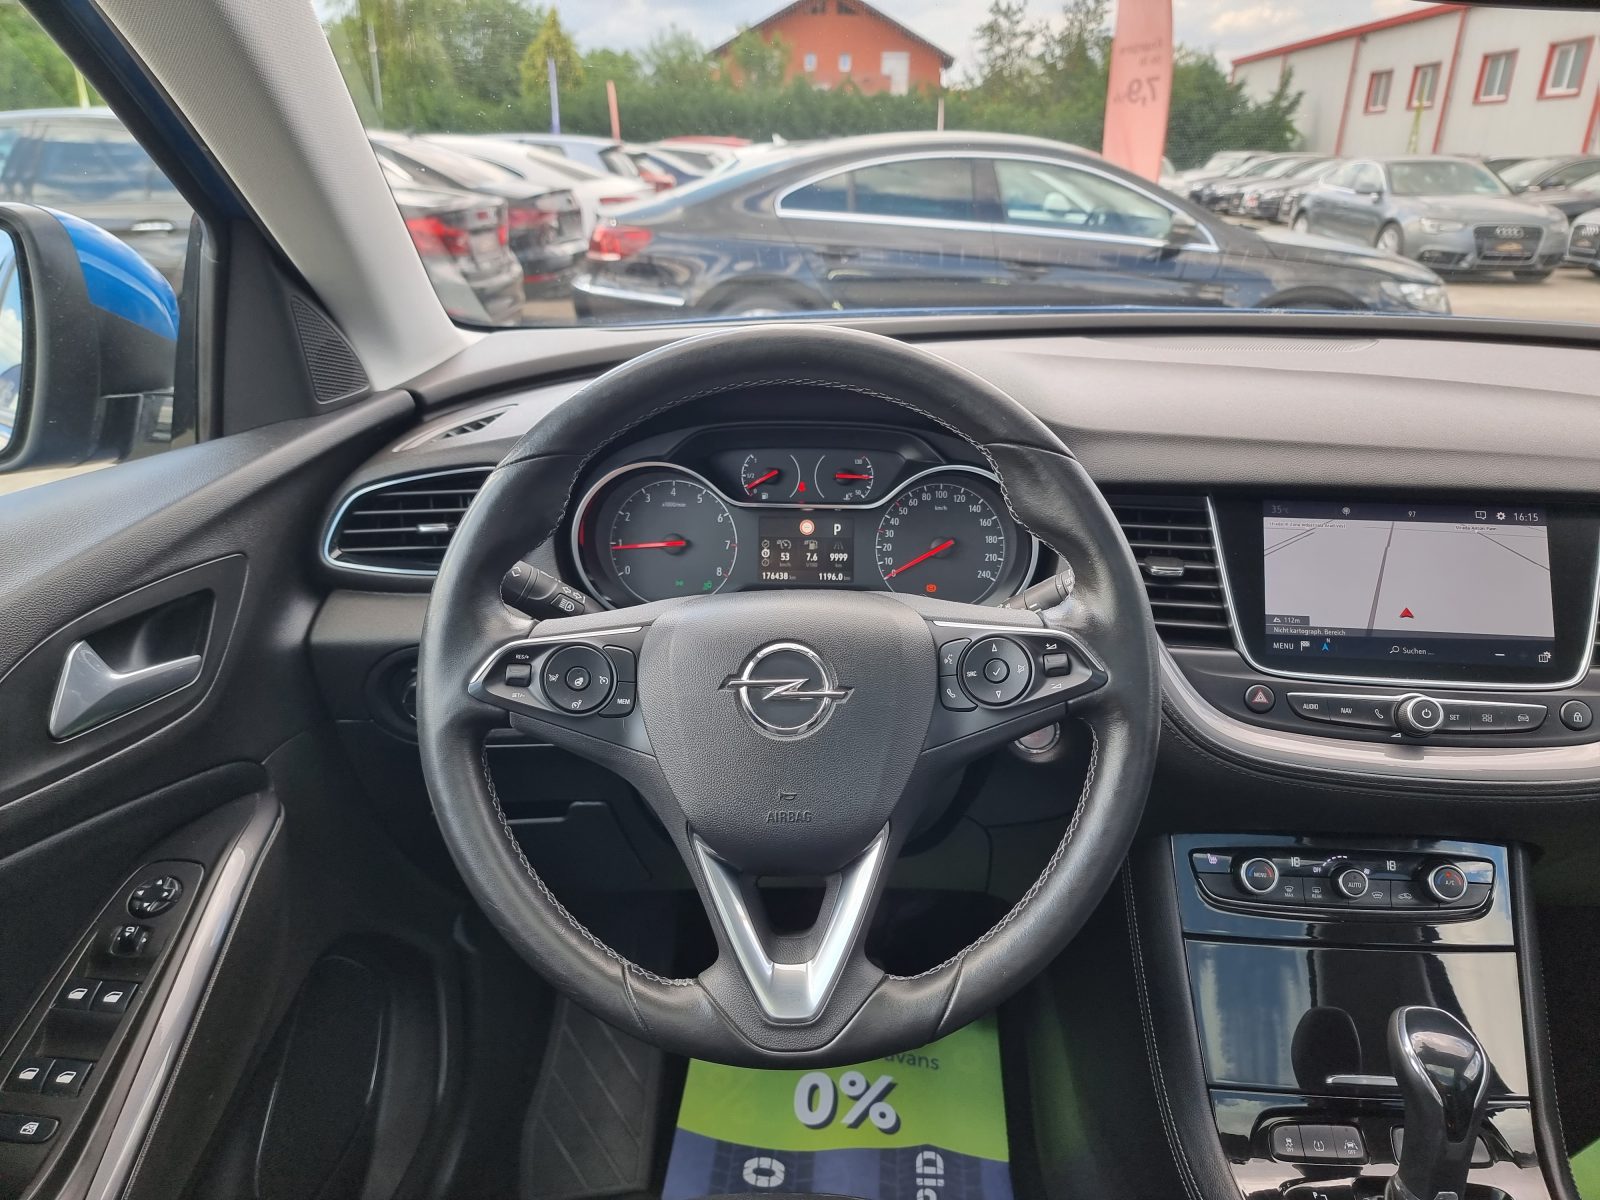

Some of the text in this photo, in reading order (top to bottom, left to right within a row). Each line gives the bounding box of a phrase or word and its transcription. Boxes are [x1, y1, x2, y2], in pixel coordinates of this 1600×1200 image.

[670, 487, 676, 497] 4
[921, 492, 931, 501] 80
[935, 490, 948, 499] 100
[645, 493, 651, 503] 3
[697, 493, 703, 503] 5
[908, 498, 918, 507] 60
[953, 494, 966, 503] 120
[899, 507, 908, 515] 50
[969, 504, 981, 513] 140
[625, 512, 631, 522] 2
[717, 513, 723, 523] 6
[1513, 512, 1539, 522] 16:15
[889, 518, 899, 526] 40
[980, 518, 992, 527] 160
[833, 523, 841, 536] P
[885, 530, 894, 538] 30
[985, 535, 998, 544] 180
[724, 540, 731, 550] 7
[882, 543, 892, 552] 20
[780, 552, 790, 561] 53
[805, 552, 818, 561] 7.6
[829, 553, 848, 562] 9999
[884, 557, 893, 565] 10
[984, 553, 998, 562] 210
[624, 565, 631, 575] 0
[716, 567, 722, 576] 8
[977, 570, 991, 579] 240
[762, 572, 788, 580] 176438
[818, 572, 843, 581] 1196.0
[1290, 627, 1323, 636] kartograph.
[1273, 642, 1294, 650] MENU
[1402, 647, 1427, 655] Suchen
[966, 670, 978, 678] SRC
[766, 810, 812, 824] AIRBAG
[793, 1071, 900, 1134] 0%
